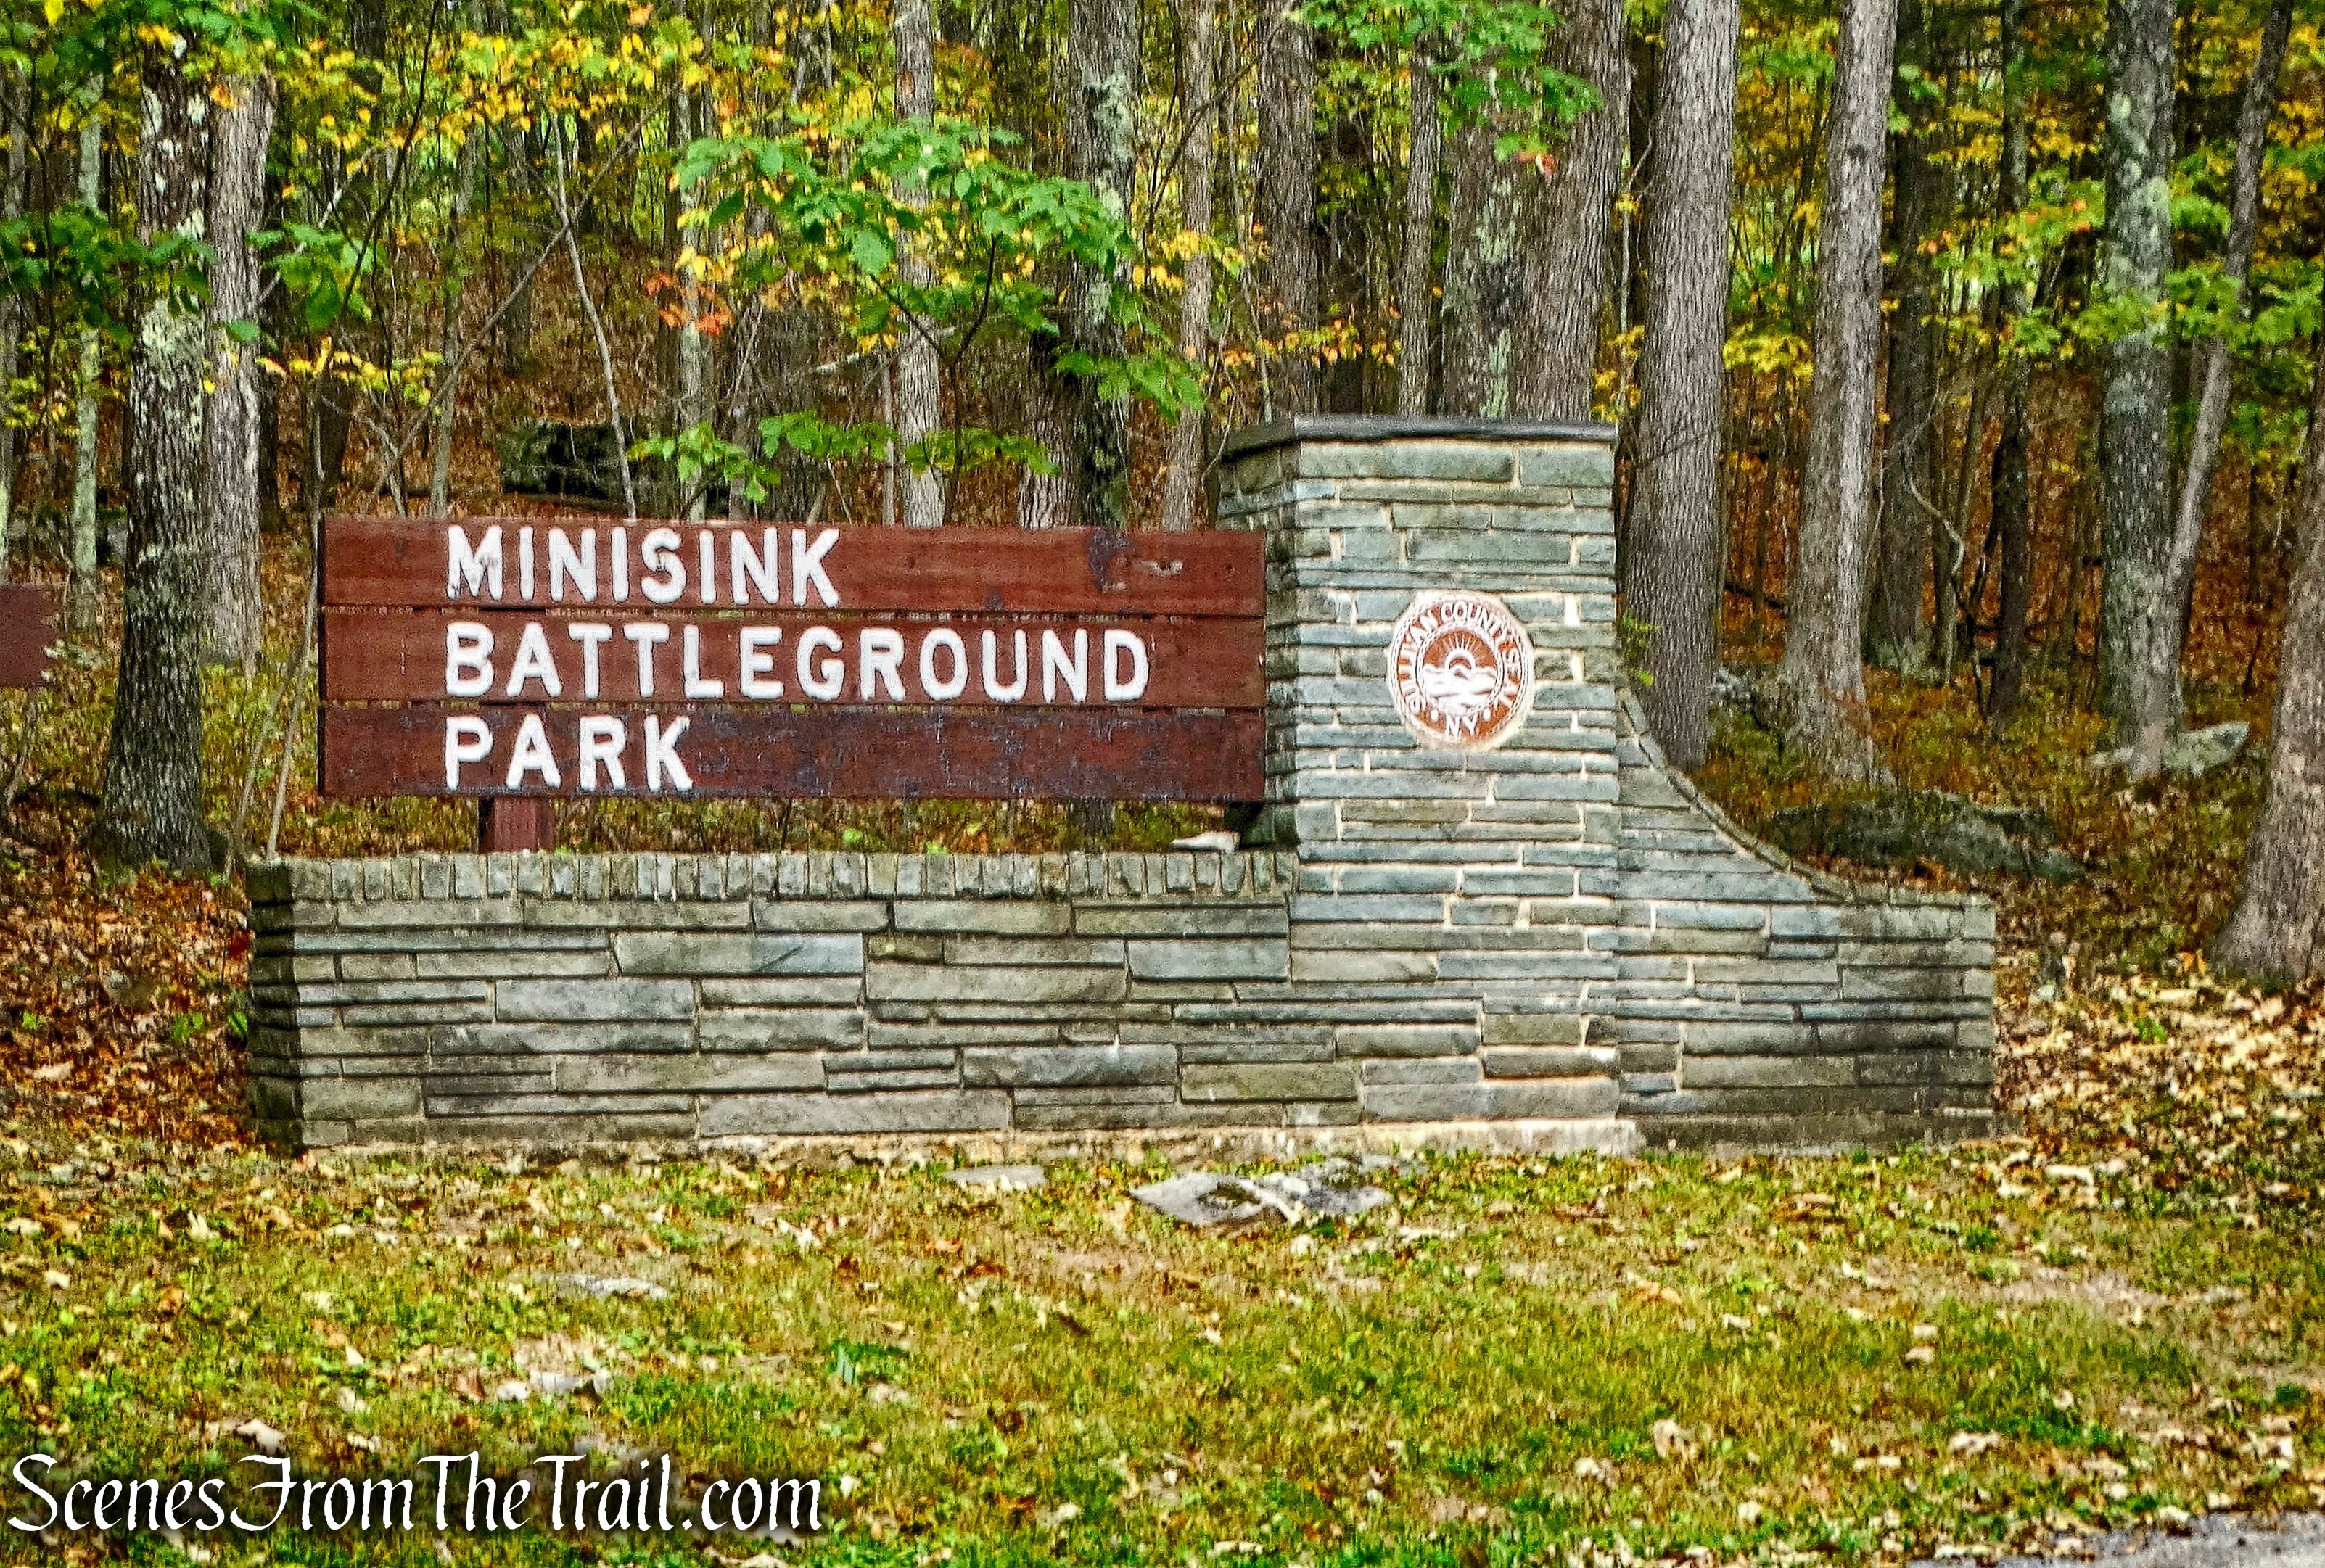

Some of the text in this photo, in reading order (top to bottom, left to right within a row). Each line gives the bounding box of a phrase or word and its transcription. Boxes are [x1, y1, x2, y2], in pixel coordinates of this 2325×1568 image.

[448, 525, 839, 608] MINISINK
[1441, 601, 1510, 644] COUNTY
[446, 622, 1148, 703] BATTLEGROUND
[445, 714, 693, 791] PARK
[1444, 714, 1479, 738] NY
